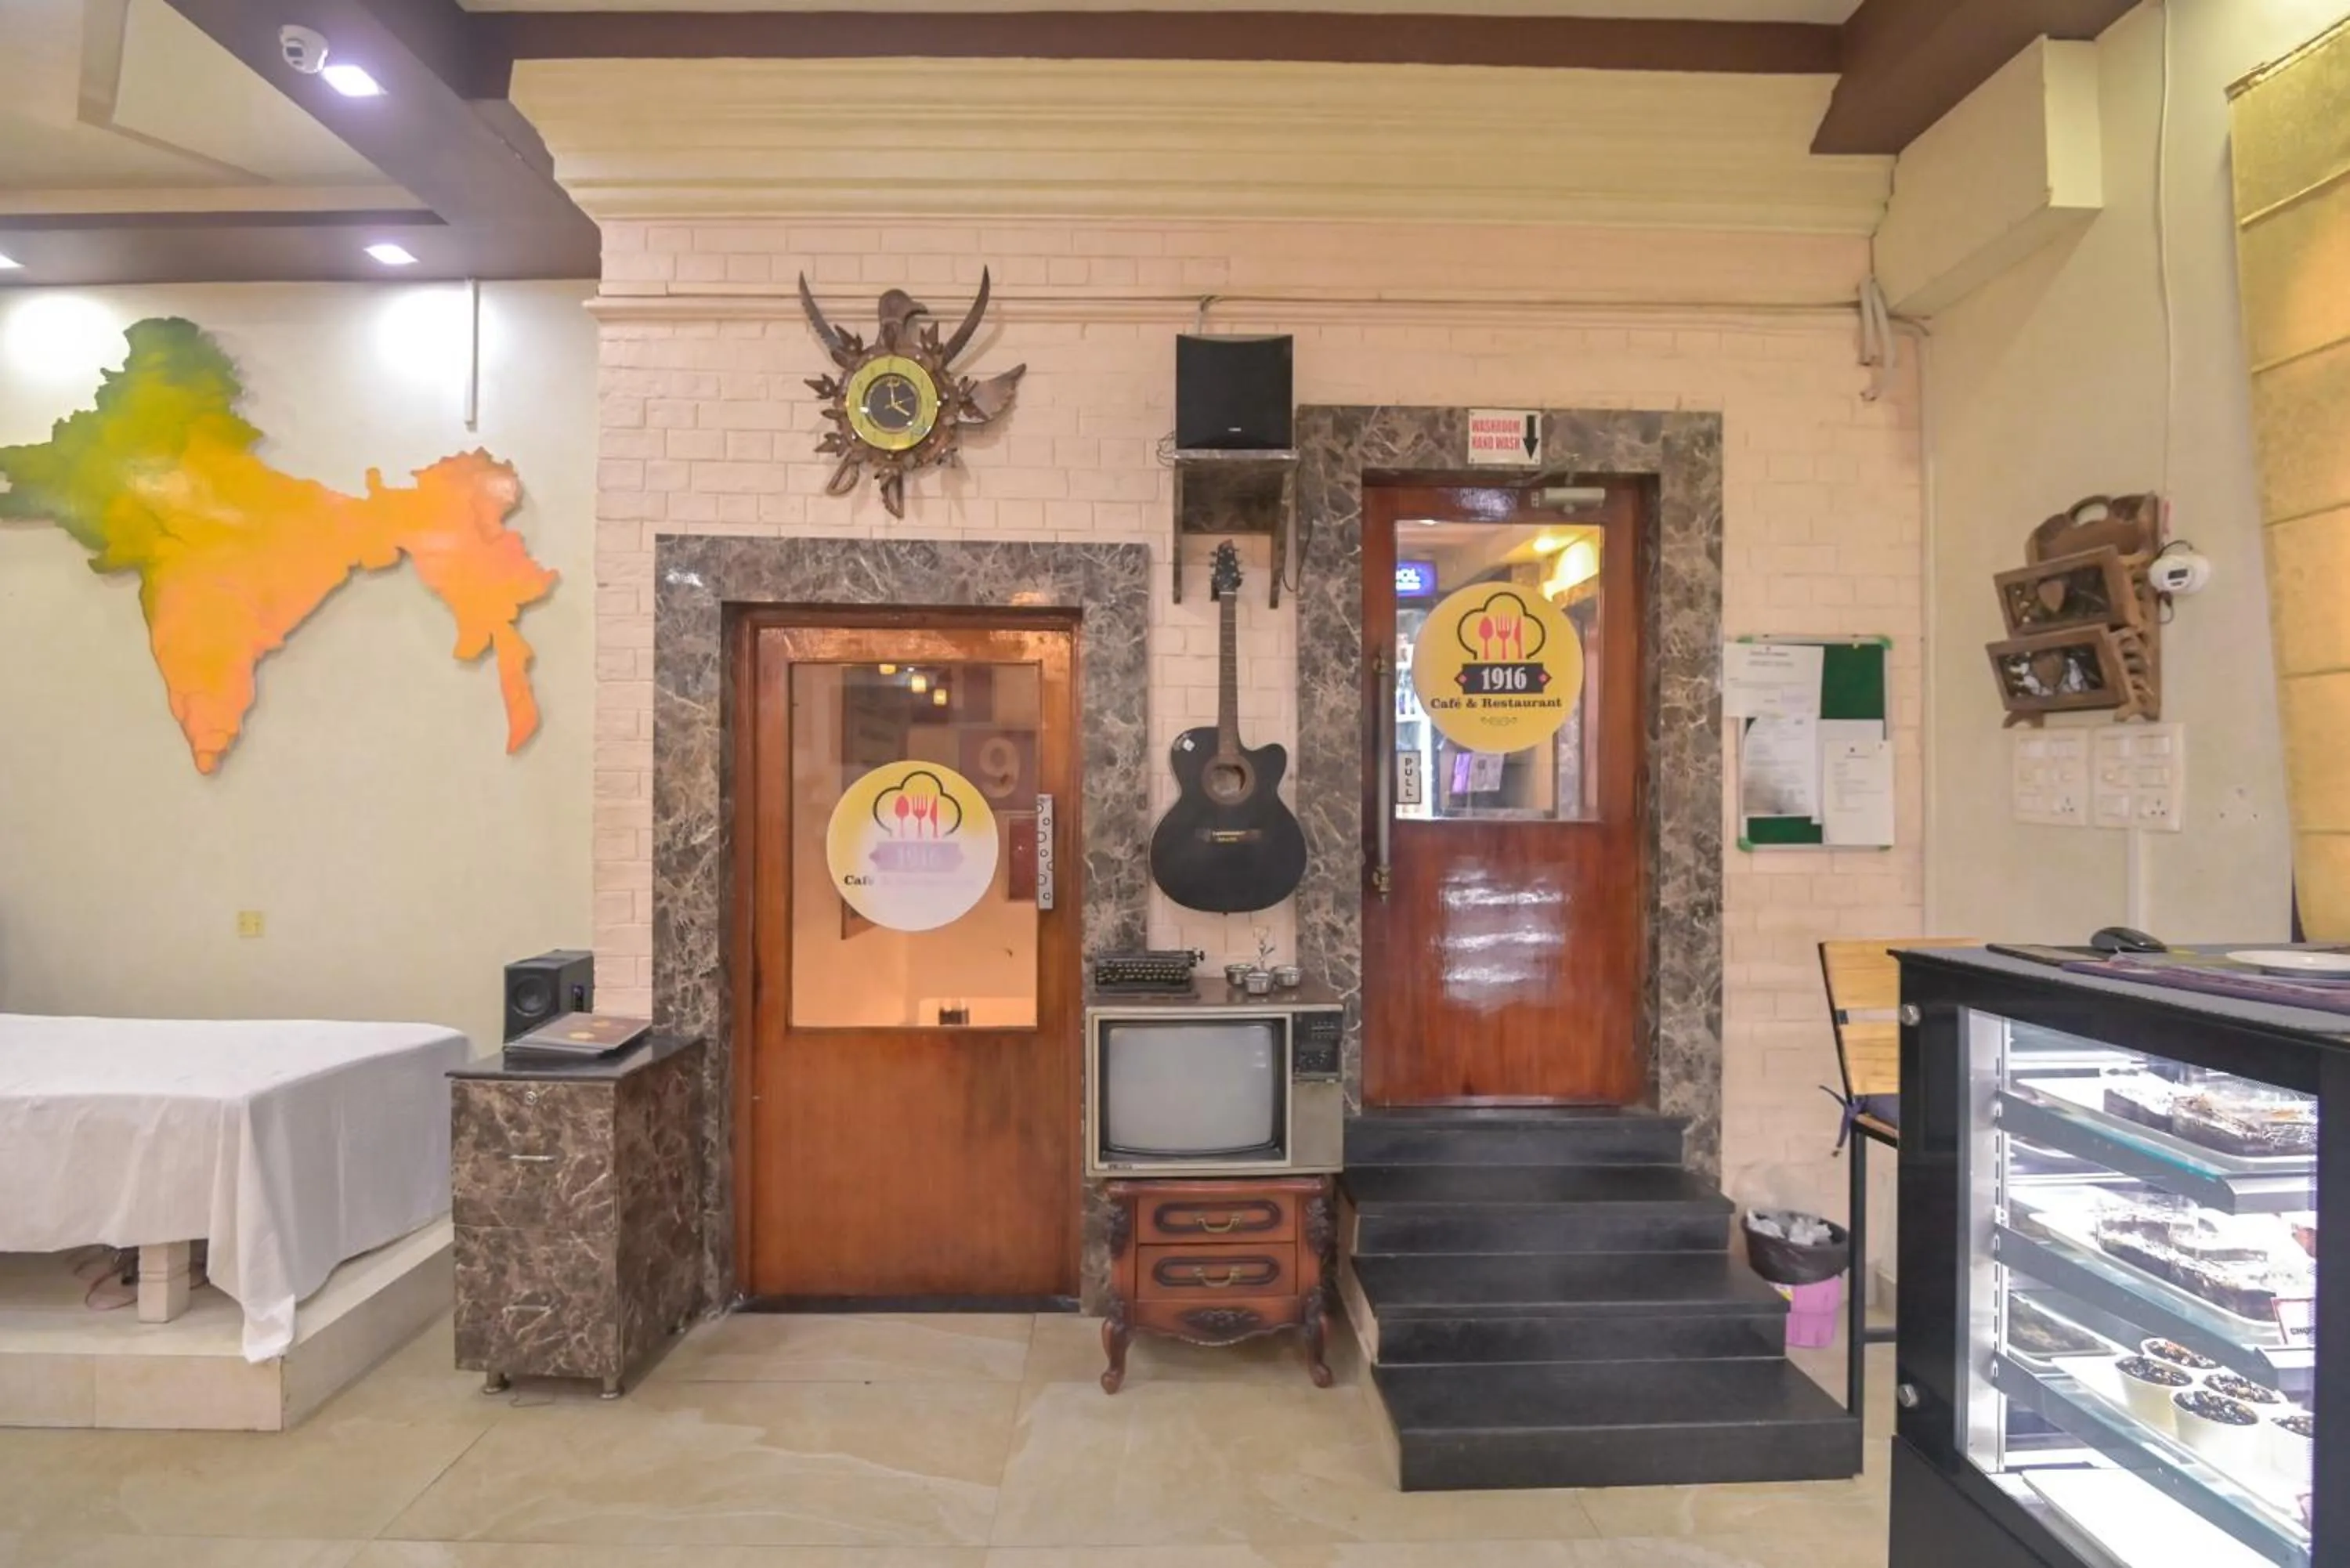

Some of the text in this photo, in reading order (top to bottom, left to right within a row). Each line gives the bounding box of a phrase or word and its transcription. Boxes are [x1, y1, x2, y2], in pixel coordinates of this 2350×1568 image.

[1495, 435, 1520, 450] WASH
[1481, 667, 1528, 690] 1916
[1430, 697, 1562, 709] Café & Restaurant
[1404, 757, 1413, 797] PULL
